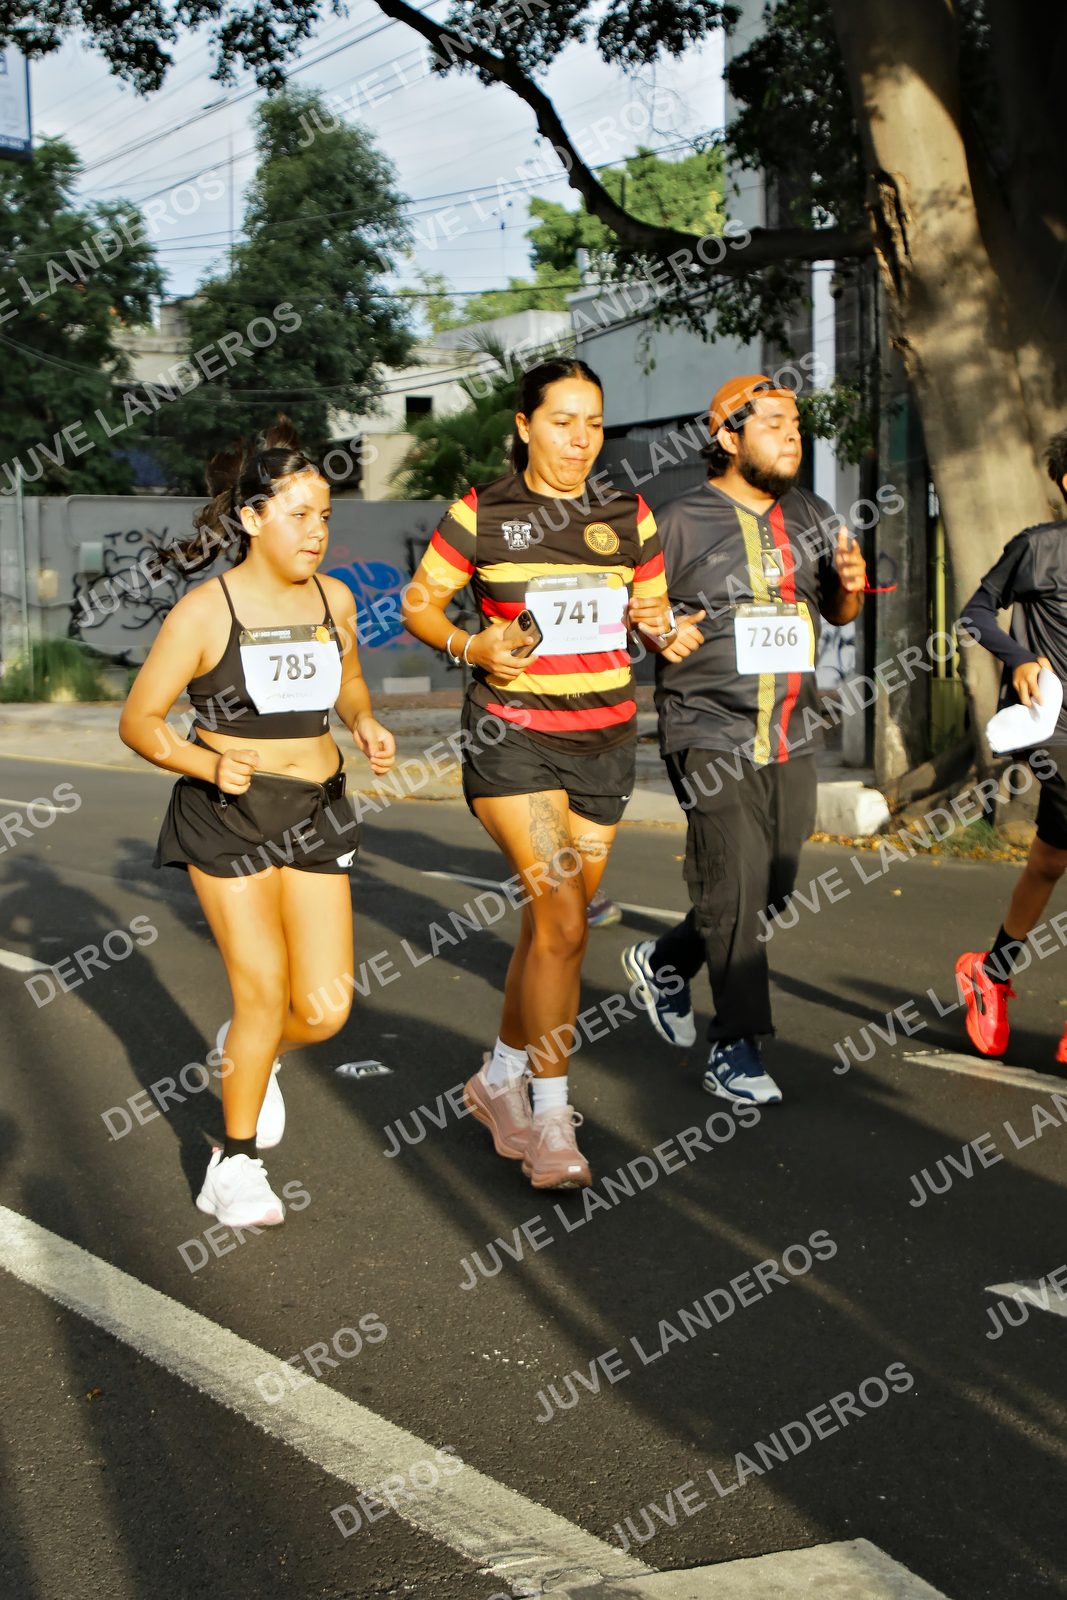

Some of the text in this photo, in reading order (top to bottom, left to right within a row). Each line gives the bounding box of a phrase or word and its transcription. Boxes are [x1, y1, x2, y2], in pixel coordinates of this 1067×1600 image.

[553, 600, 598, 625] 741
[748, 627, 798, 647] 7266
[269, 653, 316, 681] 785
